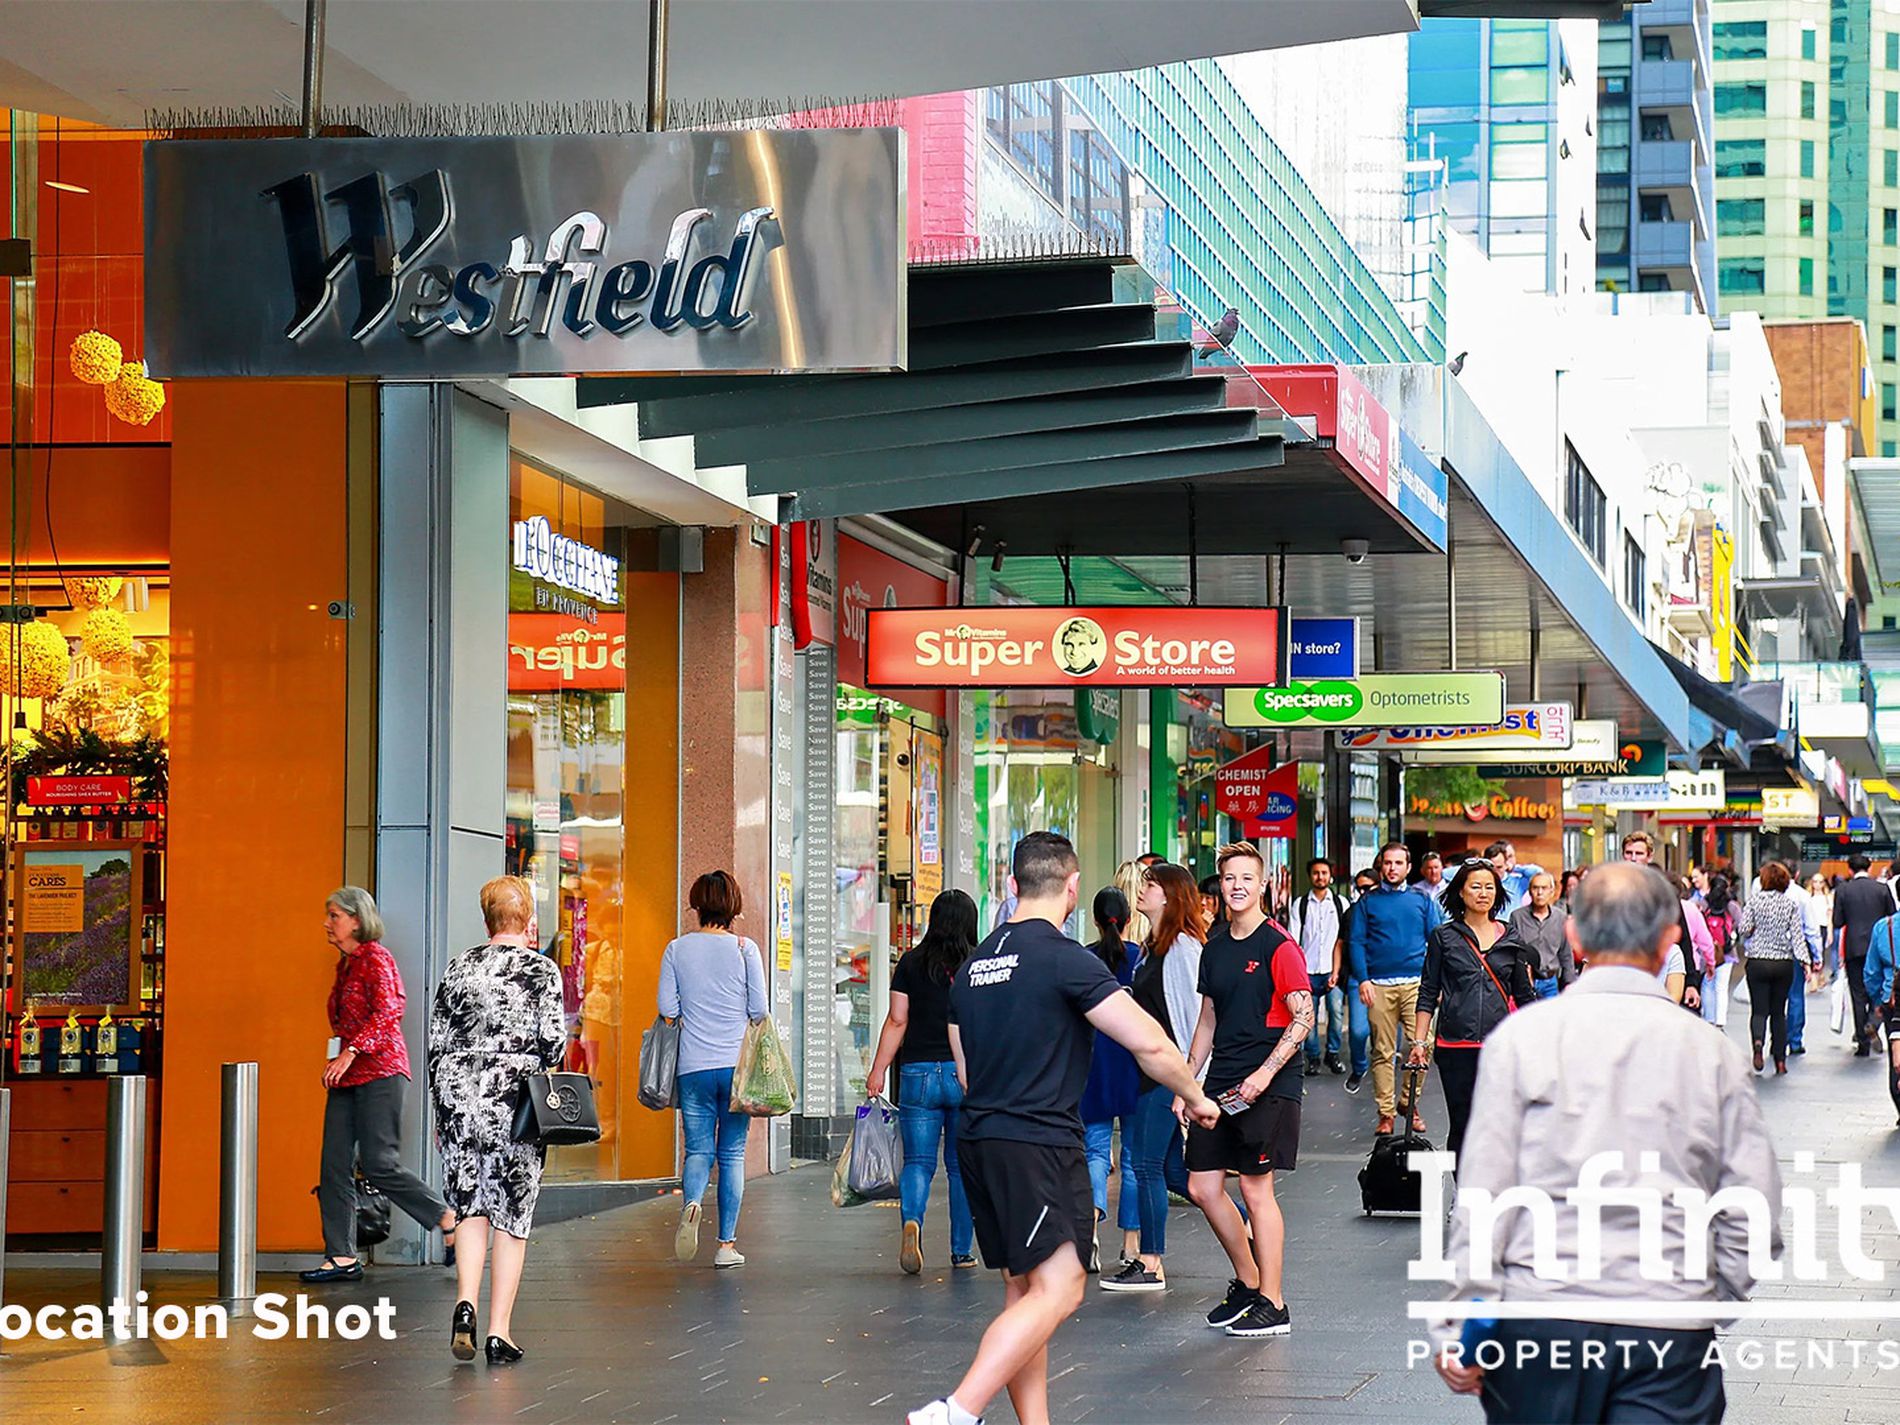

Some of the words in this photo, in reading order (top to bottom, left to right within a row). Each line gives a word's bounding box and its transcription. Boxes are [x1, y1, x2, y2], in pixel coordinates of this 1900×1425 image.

[257, 167, 784, 341] Westfield
[552, 594, 599, 625] PROVENCE
[915, 630, 1044, 677] Super
[1114, 629, 1235, 666] Store
[1305, 642, 1341, 655] store?
[1116, 666, 1125, 675] A
[1128, 666, 1156, 675] world
[1158, 666, 1169, 675] of
[1170, 666, 1202, 675] better
[1204, 666, 1236, 675] health
[1264, 691, 1353, 712] Specsavers
[1370, 690, 1470, 708] Optometrists
[1583, 758, 1629, 775] BANK
[1217, 769, 1268, 781] CHEMIST
[56, 784, 79, 792] BODY
[80, 783, 101, 791] CARE
[1225, 785, 1261, 797] OPEN
[1489, 795, 1556, 819] Coffees
[808, 859, 827, 867] Save
[29, 876, 66, 887] CARES
[808, 926, 827, 934] Save
[808, 937, 827, 945] Save
[968, 954, 1019, 975] PERSONAL
[970, 968, 1012, 988] TRAINER
[808, 993, 826, 1001] Save
[808, 1004, 826, 1012] Save
